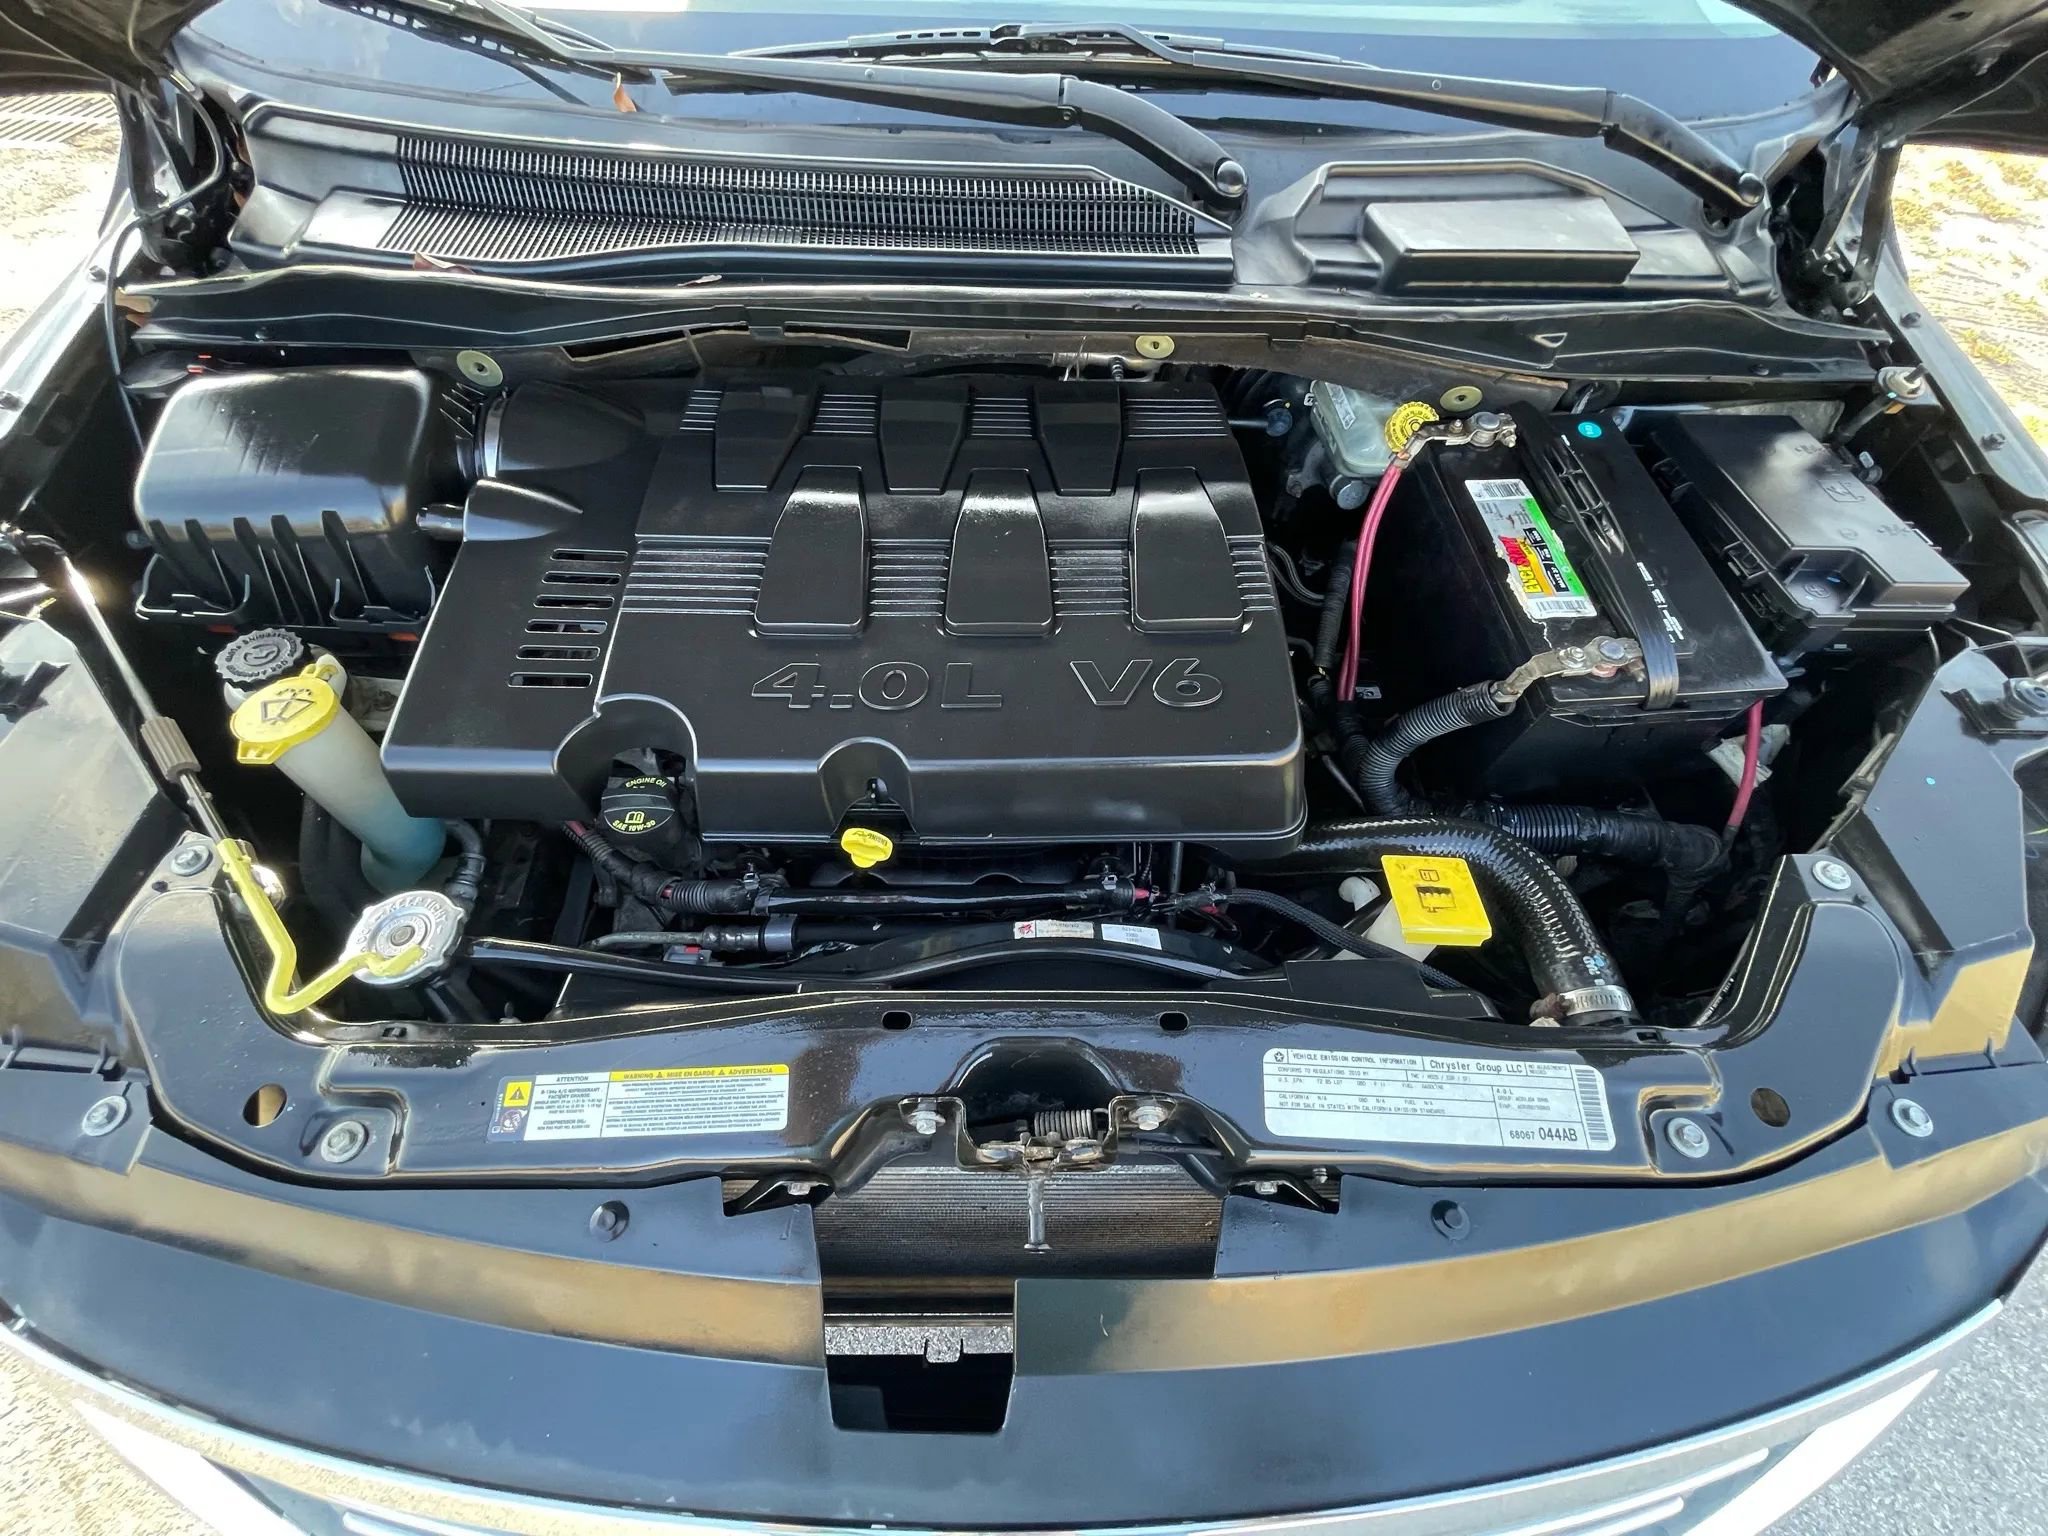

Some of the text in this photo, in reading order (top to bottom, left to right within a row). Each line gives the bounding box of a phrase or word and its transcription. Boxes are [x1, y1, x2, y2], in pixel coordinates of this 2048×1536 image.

[751, 657, 1224, 711] 4.0L V6
[625, 777, 668, 788] ENGINE OIL
[612, 819, 628, 831] SAE
[1292, 1053, 1417, 1065] VEHICLE EMISSION CONTROL INFORMATION
[1429, 1059, 1522, 1074] Chrysler Group LLC
[1509, 1127, 1578, 1141] 68067 044AB
